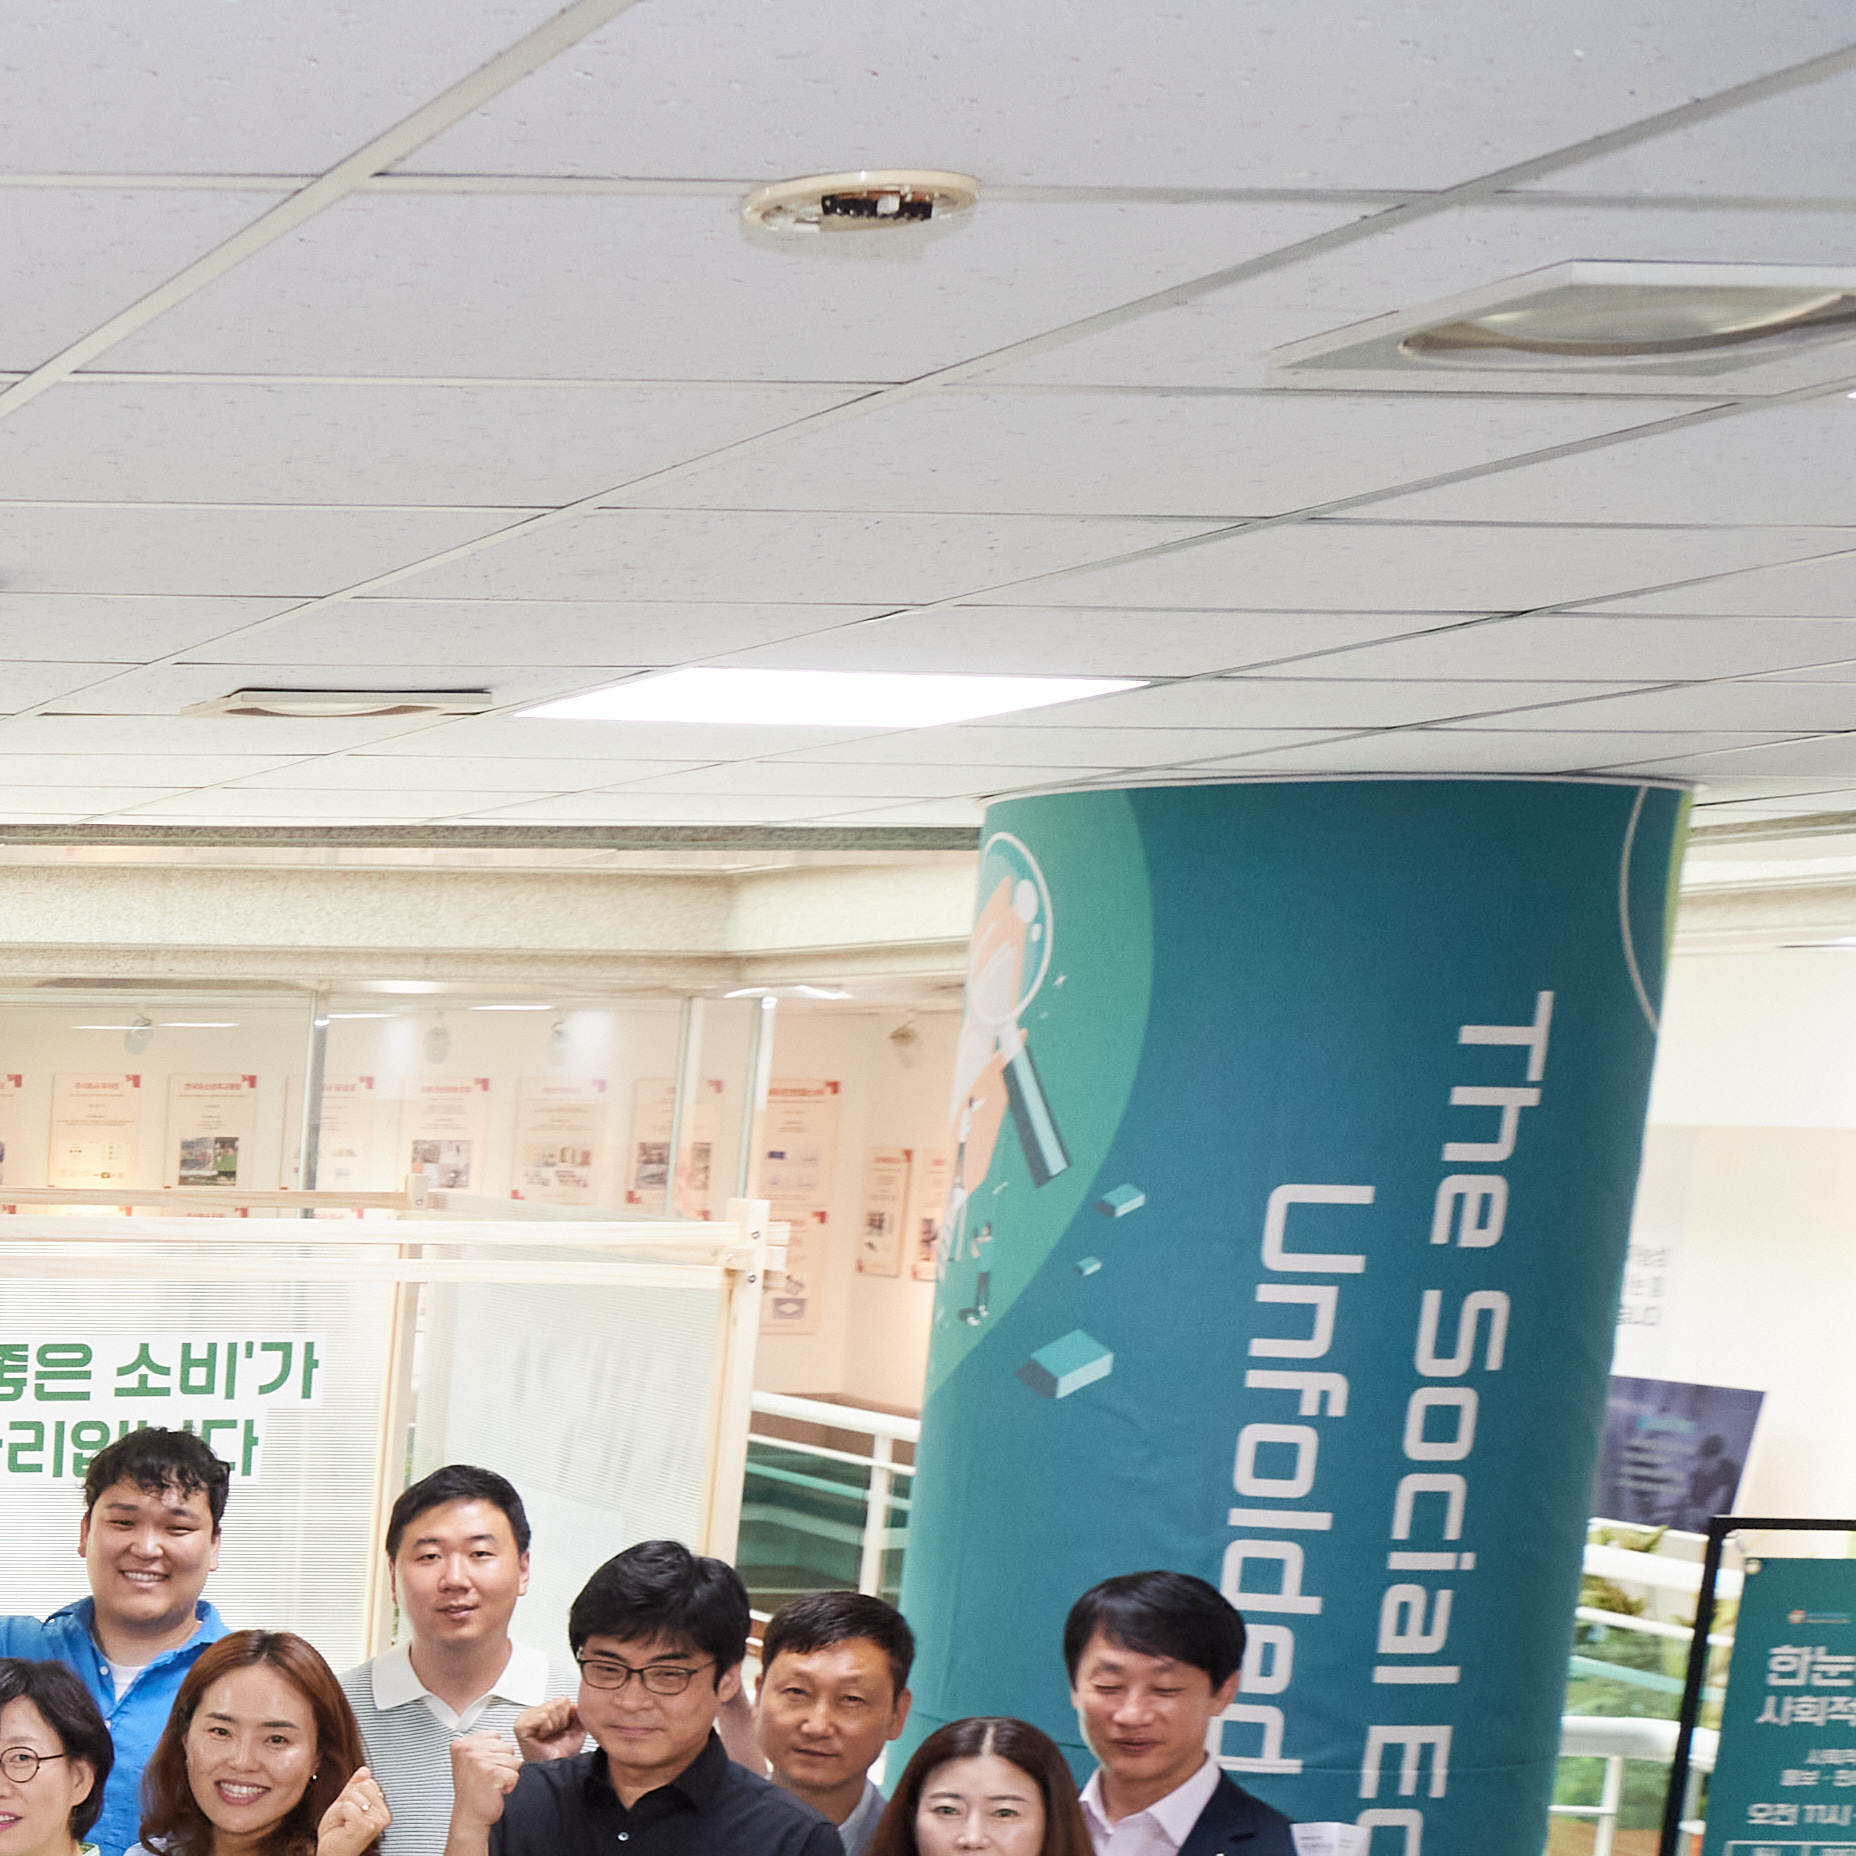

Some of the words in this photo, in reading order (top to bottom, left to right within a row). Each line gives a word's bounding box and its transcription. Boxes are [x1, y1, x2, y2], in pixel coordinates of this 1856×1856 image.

[1428, 992, 1555, 1249] The
[114, 1341, 320, 1402] 소비'가
[1203, 1184, 1375, 1775] Unfolded
[1375, 1289, 1509, 1685] Social
